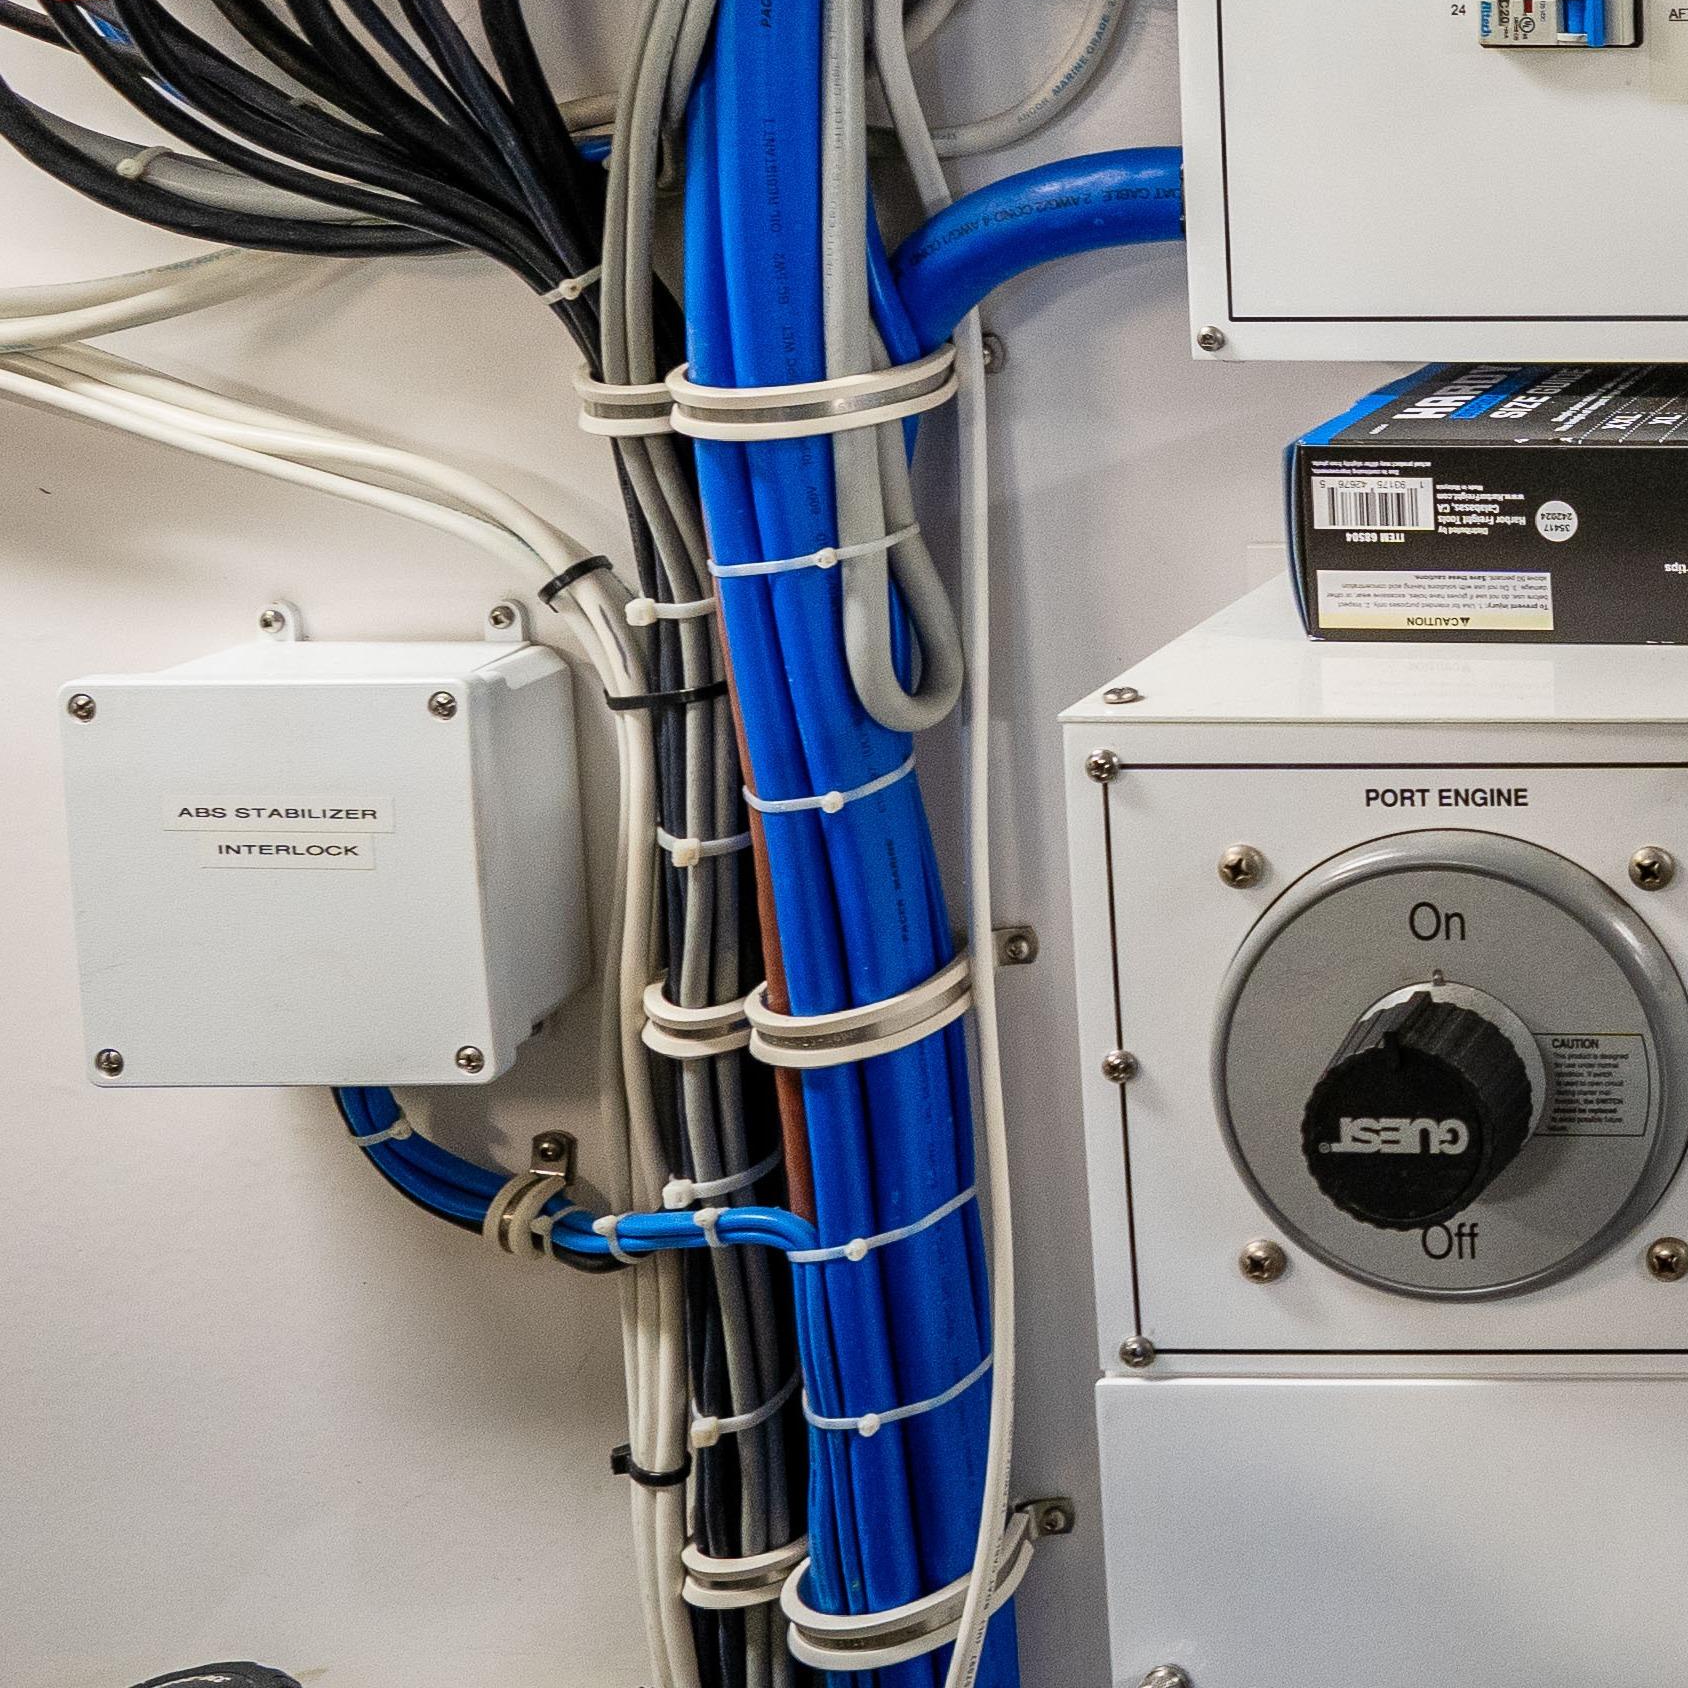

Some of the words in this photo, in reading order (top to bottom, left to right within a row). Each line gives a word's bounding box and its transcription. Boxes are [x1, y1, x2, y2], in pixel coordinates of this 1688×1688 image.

[1365, 788, 1431, 808] PORT
[1437, 787, 1528, 807] ENGINE
[177, 807, 226, 820] ABS
[234, 807, 378, 821] STABILIZER
[216, 843, 359, 857] INTERLOCK
[1408, 902, 1466, 943] On
